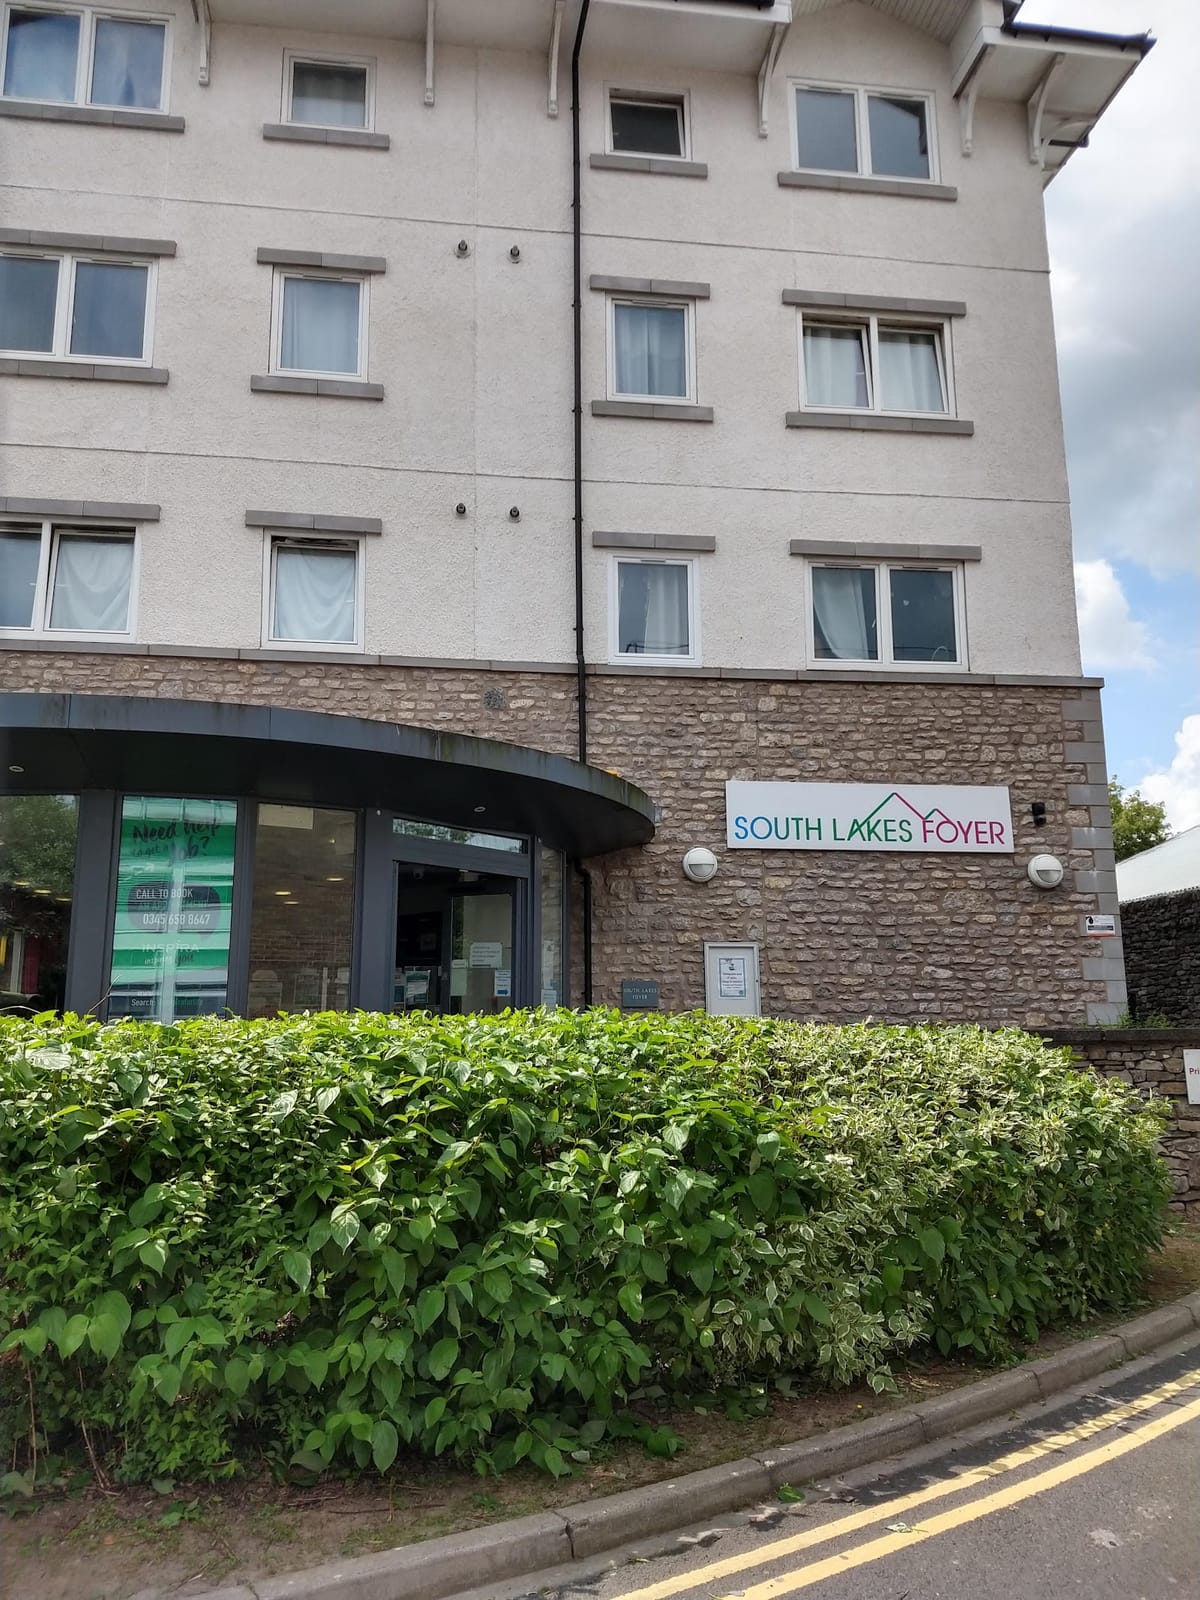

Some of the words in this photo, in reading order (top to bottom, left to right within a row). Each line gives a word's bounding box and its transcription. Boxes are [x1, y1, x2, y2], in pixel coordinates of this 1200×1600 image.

[132, 818, 177, 844] Need
[734, 816, 822, 841] SOUTH
[832, 817, 913, 843] LAKES
[921, 819, 1005, 845] FOYER
[136, 888, 156, 900] CALL
[159, 888, 169, 899] TO
[170, 887, 194, 899] BOOK
[143, 913, 167, 926] 0345
[168, 913, 186, 926] 658
[188, 913, 211, 926] 8647
[142, 942, 200, 953] INSPIRA
